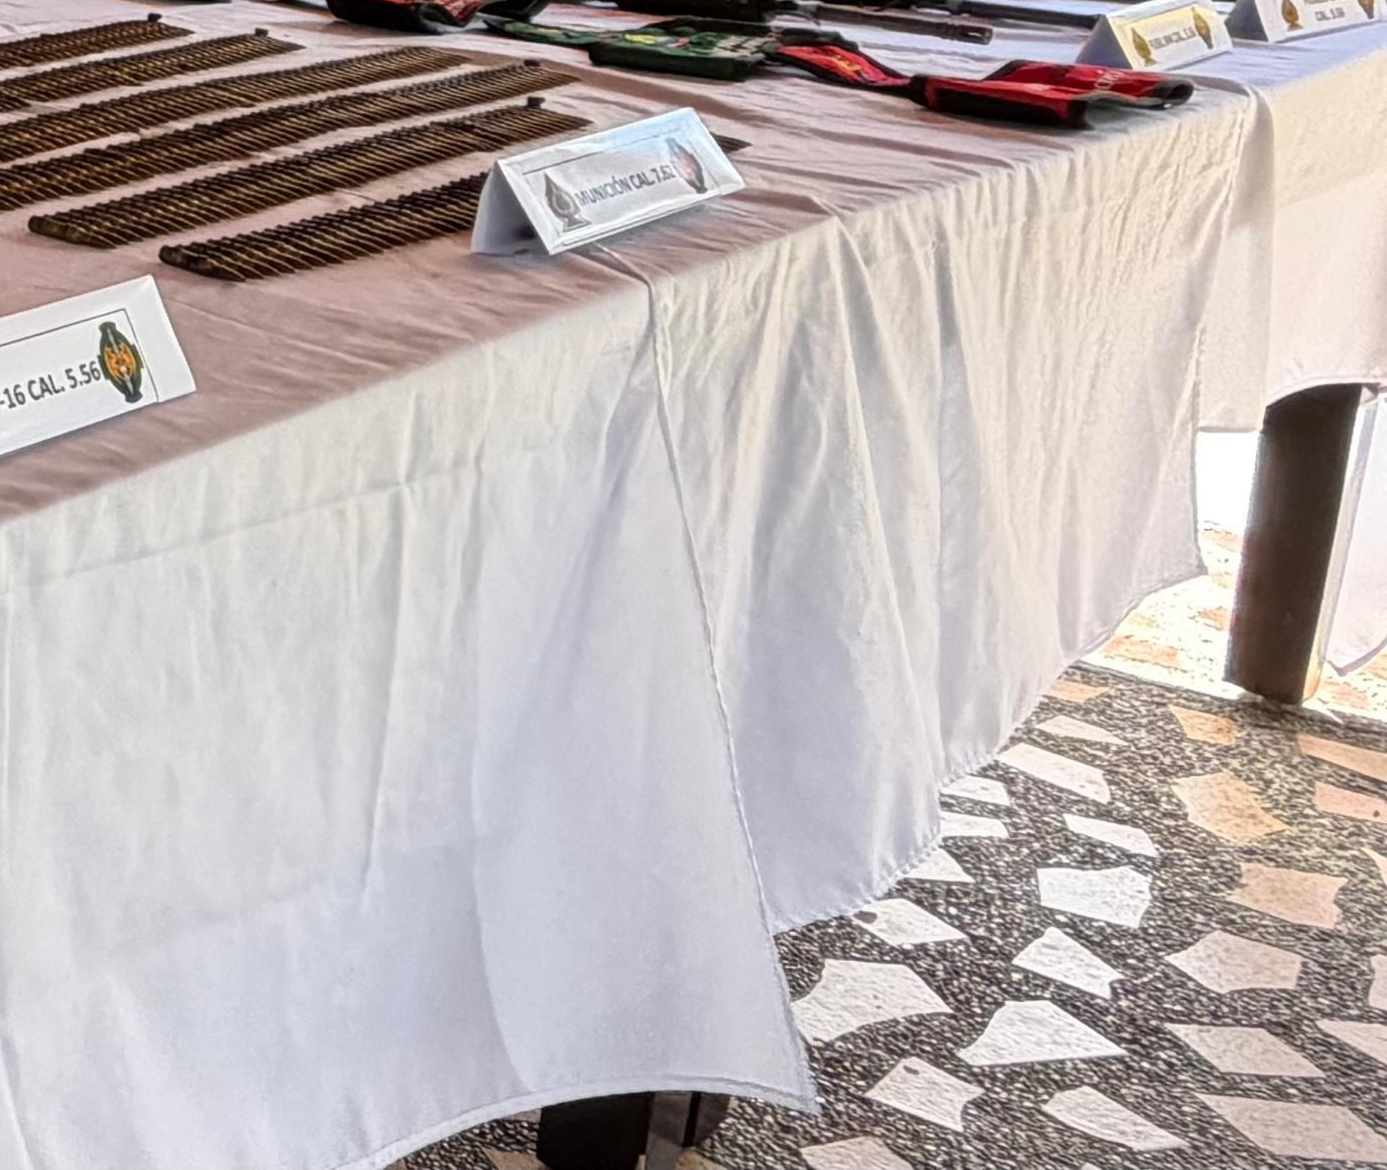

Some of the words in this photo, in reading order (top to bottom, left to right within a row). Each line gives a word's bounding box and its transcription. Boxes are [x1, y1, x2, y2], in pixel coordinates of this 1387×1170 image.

[574, 175, 633, 206] MUNICIÓN
[28, 376, 65, 403] CAL.
[65, 359, 101, 390] 5.56
